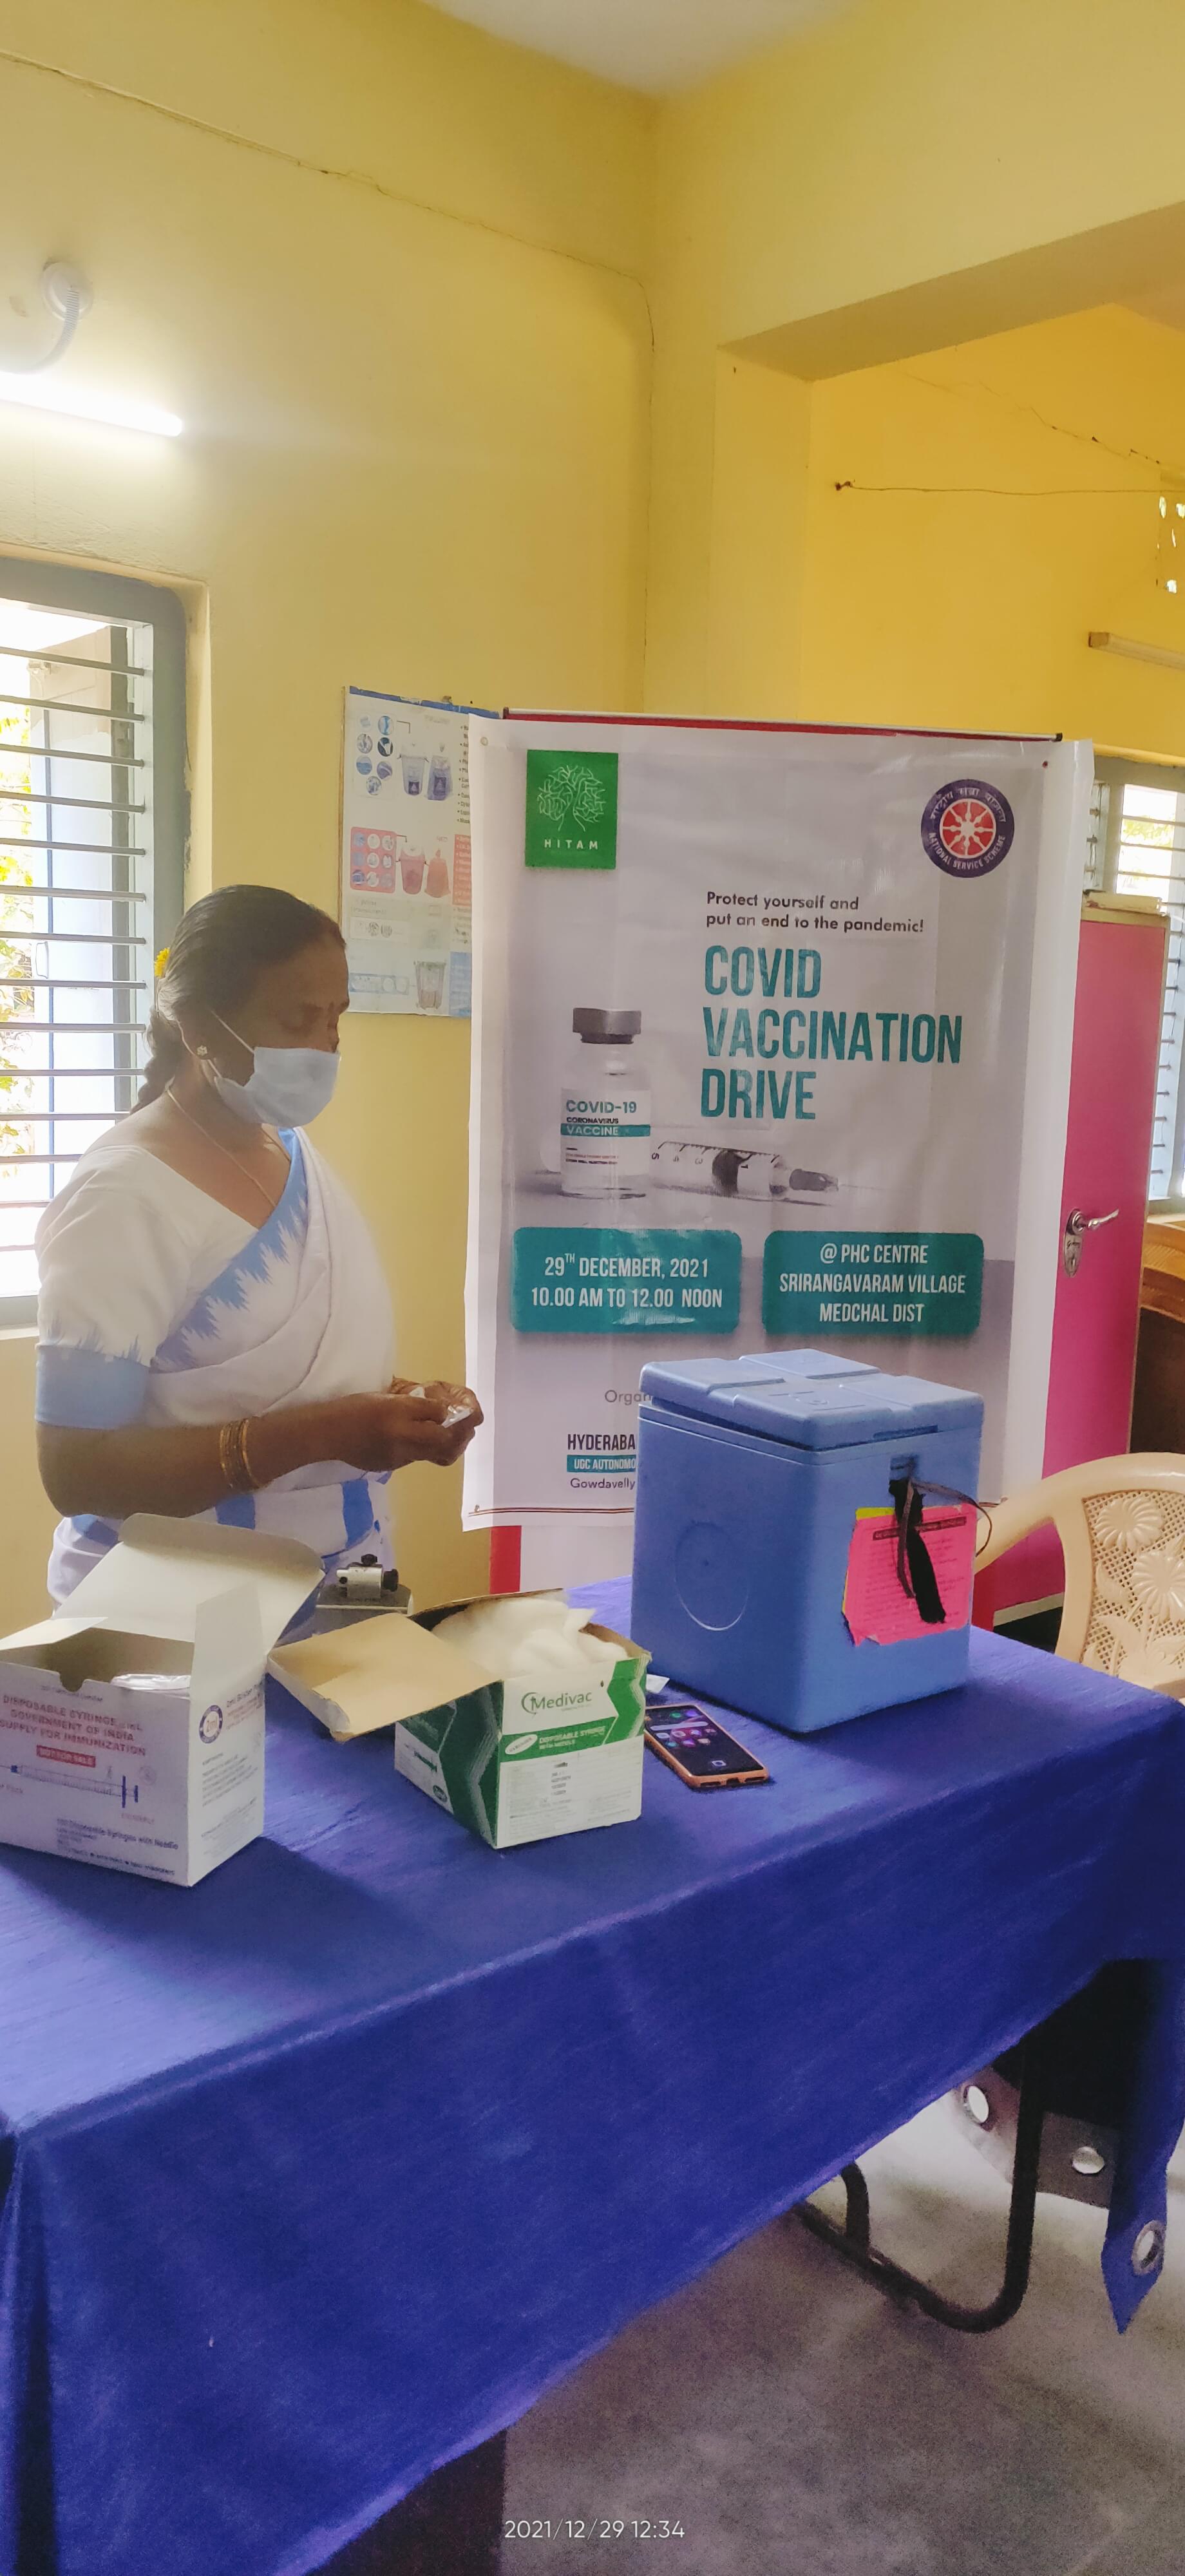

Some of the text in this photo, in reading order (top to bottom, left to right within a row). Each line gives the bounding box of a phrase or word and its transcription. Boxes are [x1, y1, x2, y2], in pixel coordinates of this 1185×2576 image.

[544, 839, 598, 850] HITAM
[929, 833, 1006, 870] NATIONAL SERVICE SCHEME
[707, 891, 859, 910] Protect yourself and
[706, 914, 924, 933] put an end to the pandemic!
[705, 945, 822, 998] COVID
[703, 1007, 962, 1063] VACCINATION
[701, 1068, 816, 1119] DRIVE
[566, 1100, 637, 1113] COVID-19
[566, 1126, 620, 1135] VACCINE
[820, 1243, 929, 1264] @ PHC CENTRE
[579, 1258, 665, 1280] DECEMBER,
[670, 1258, 708, 1278] 2021
[779, 1273, 966, 1294] SRIRANGAVARAM VILLAGE
[531, 1287, 723, 1308] 10.00 AM TO 12.00 NOON
[819, 1303, 925, 1323] MEDCHAL DIST
[567, 1434, 636, 1450] HYDERABA
[574, 1459, 591, 1470] UGC
[570, 1477, 636, 1490] Gowdavelly
[3, 1694, 116, 1726] DISPOSABLE SYRINGE
[530, 1692, 592, 1710] Medivac
[10, 1709, 134, 1742] GOVERNMENT OF INDIA
[0, 1719, 146, 1756] SUPPLY FOR IMMUNIZATION
